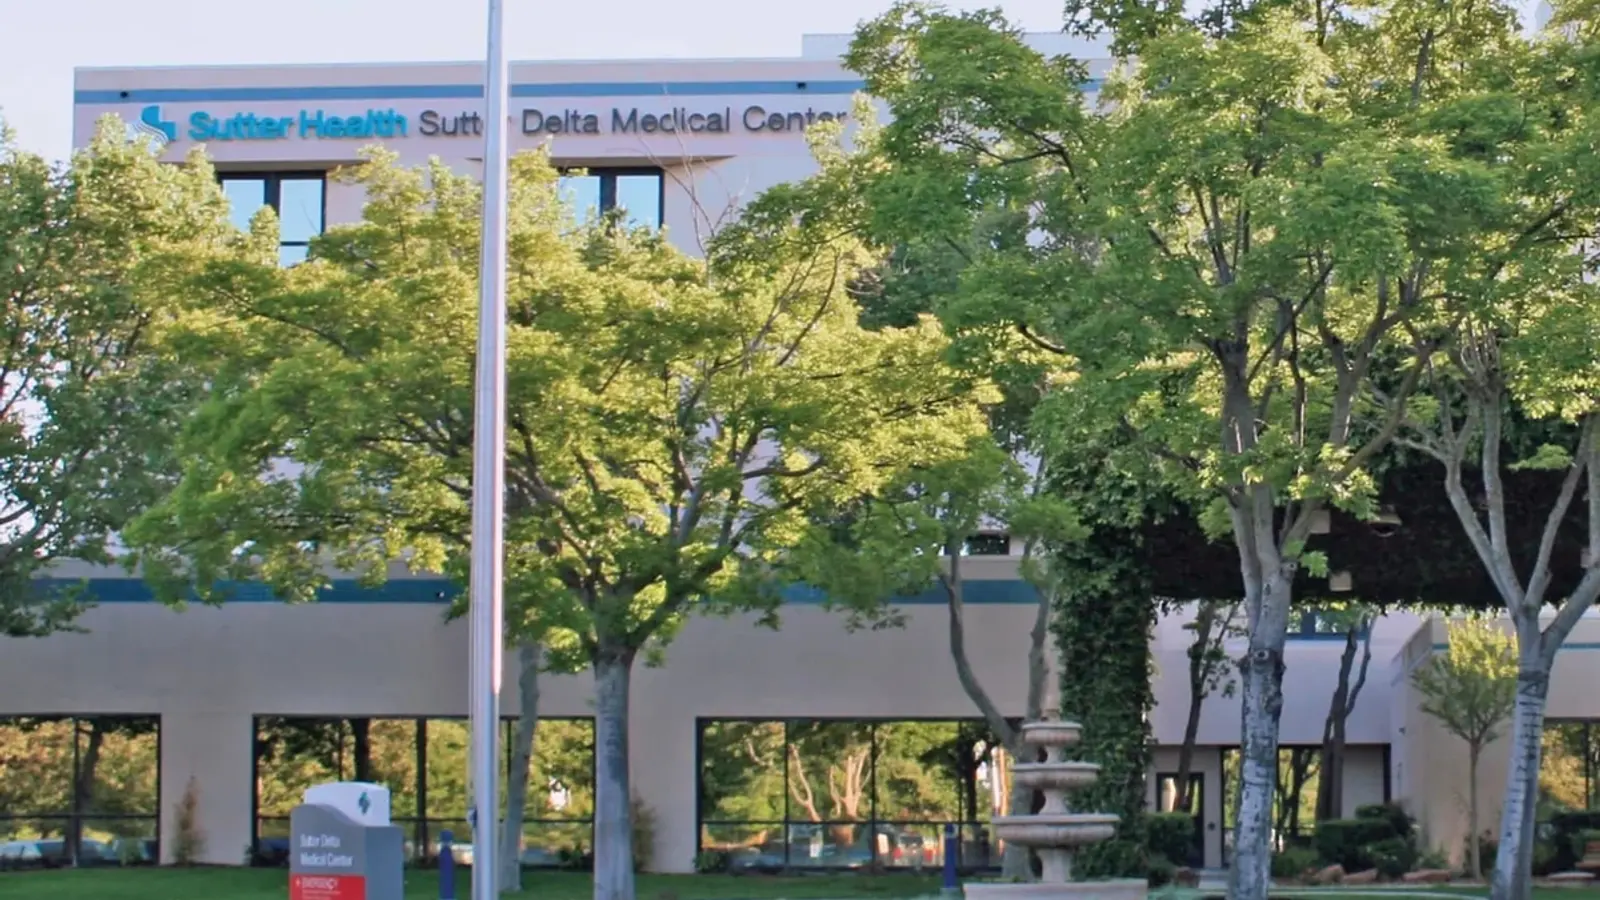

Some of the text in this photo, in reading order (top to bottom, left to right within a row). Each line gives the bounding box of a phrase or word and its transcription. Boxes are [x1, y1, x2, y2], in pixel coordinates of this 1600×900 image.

[189, 111, 293, 141] Sutter
[300, 108, 408, 138] Health
[419, 109, 512, 136] Sutt
[522, 108, 600, 134] Delta
[612, 107, 730, 133] Medical
